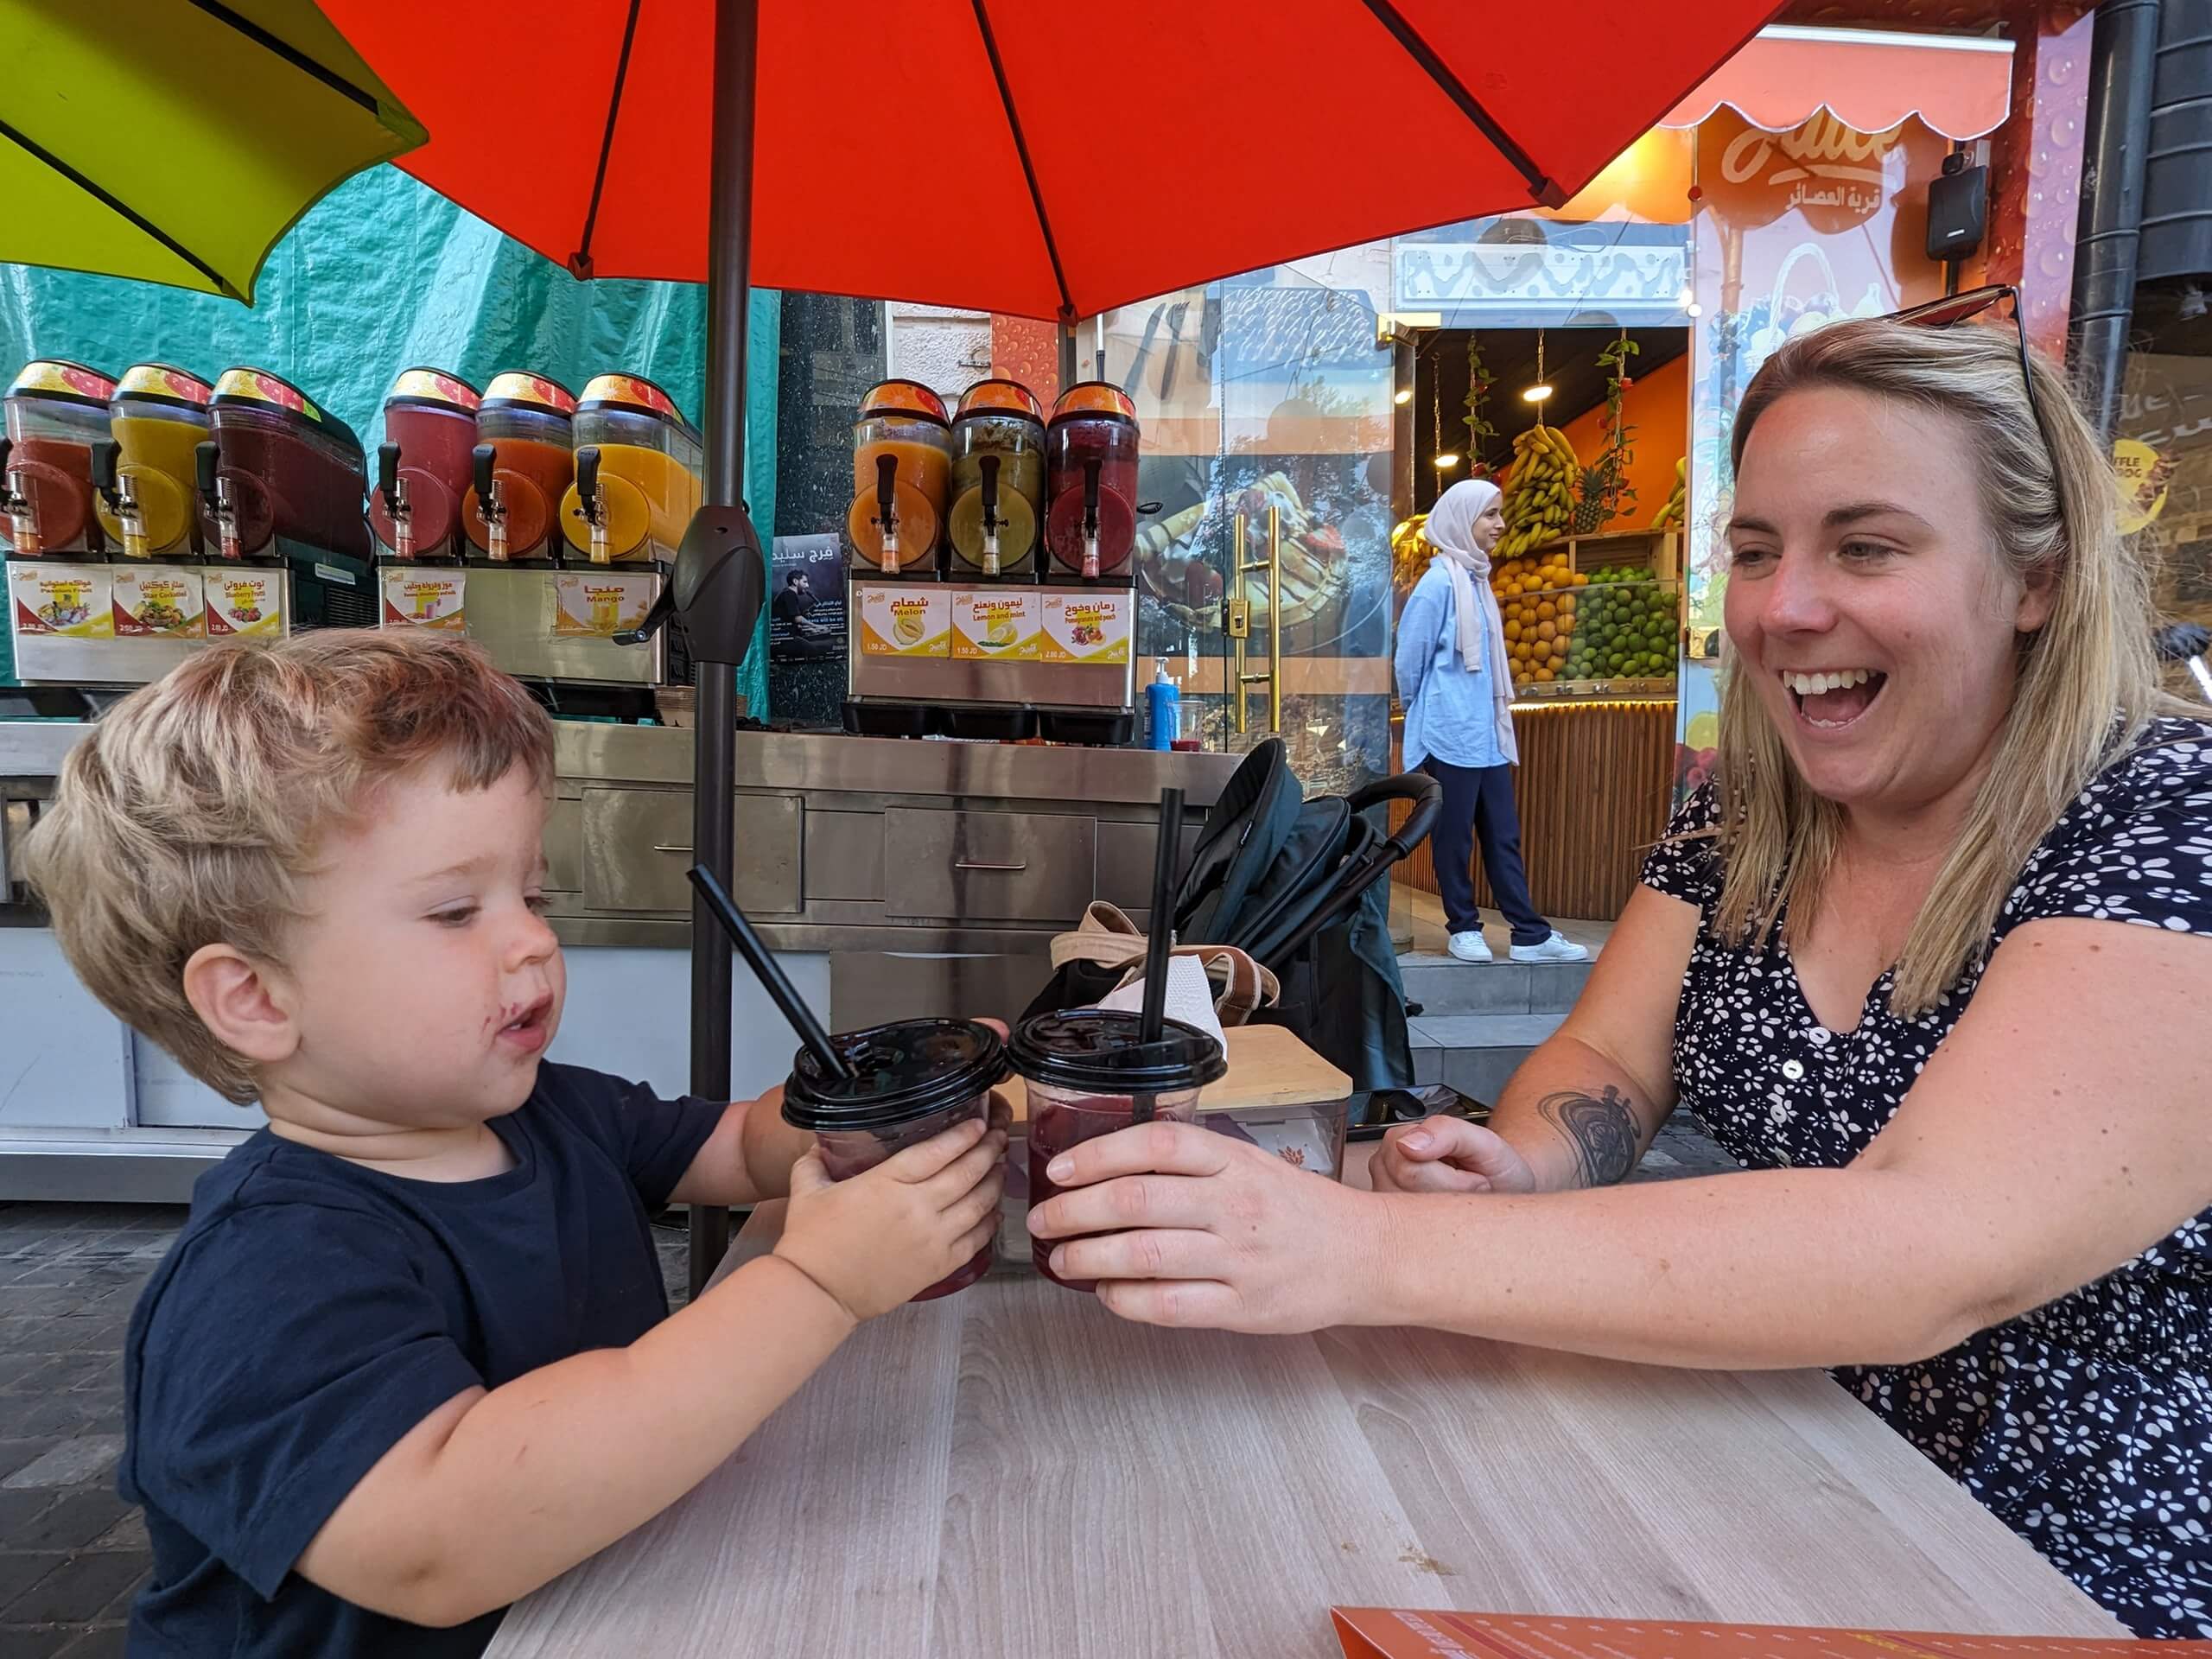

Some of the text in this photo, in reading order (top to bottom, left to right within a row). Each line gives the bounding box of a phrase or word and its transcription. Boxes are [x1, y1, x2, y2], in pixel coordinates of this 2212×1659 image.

[1784, 182, 1880, 215] قرية العصائر
[584, 586, 624, 595] منجا
[891, 597, 929, 612] شمام
[973, 597, 1023, 613] ليمون ونعنع
[1065, 601, 1116, 616] رمان وخوخ
